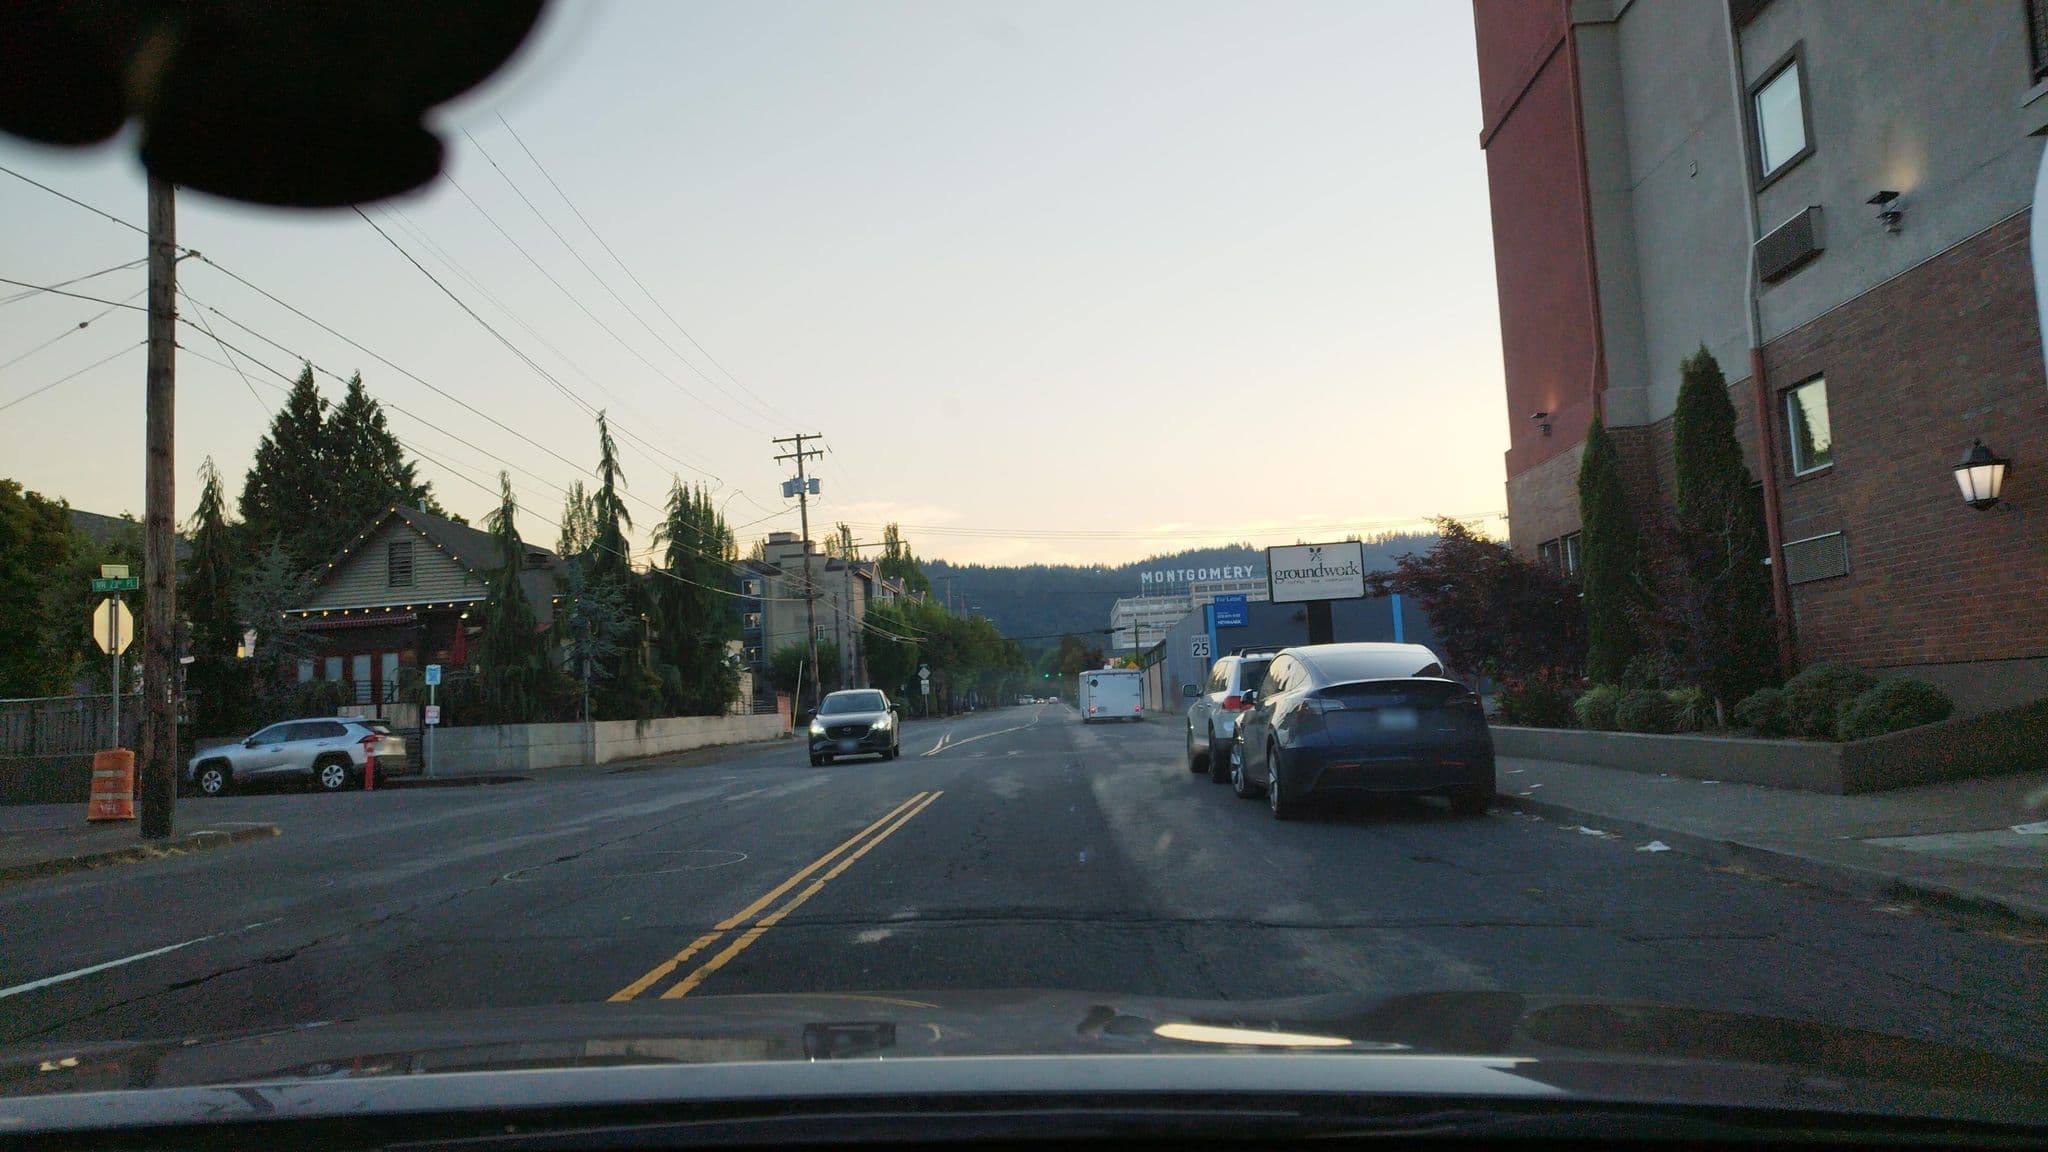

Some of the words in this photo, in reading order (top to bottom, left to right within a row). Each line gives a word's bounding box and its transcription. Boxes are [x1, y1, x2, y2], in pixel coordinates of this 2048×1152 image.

[1141, 565, 1253, 584] MONTGOMERY
[1274, 561, 1361, 585] groundwork
[1193, 643, 1209, 656] 25
